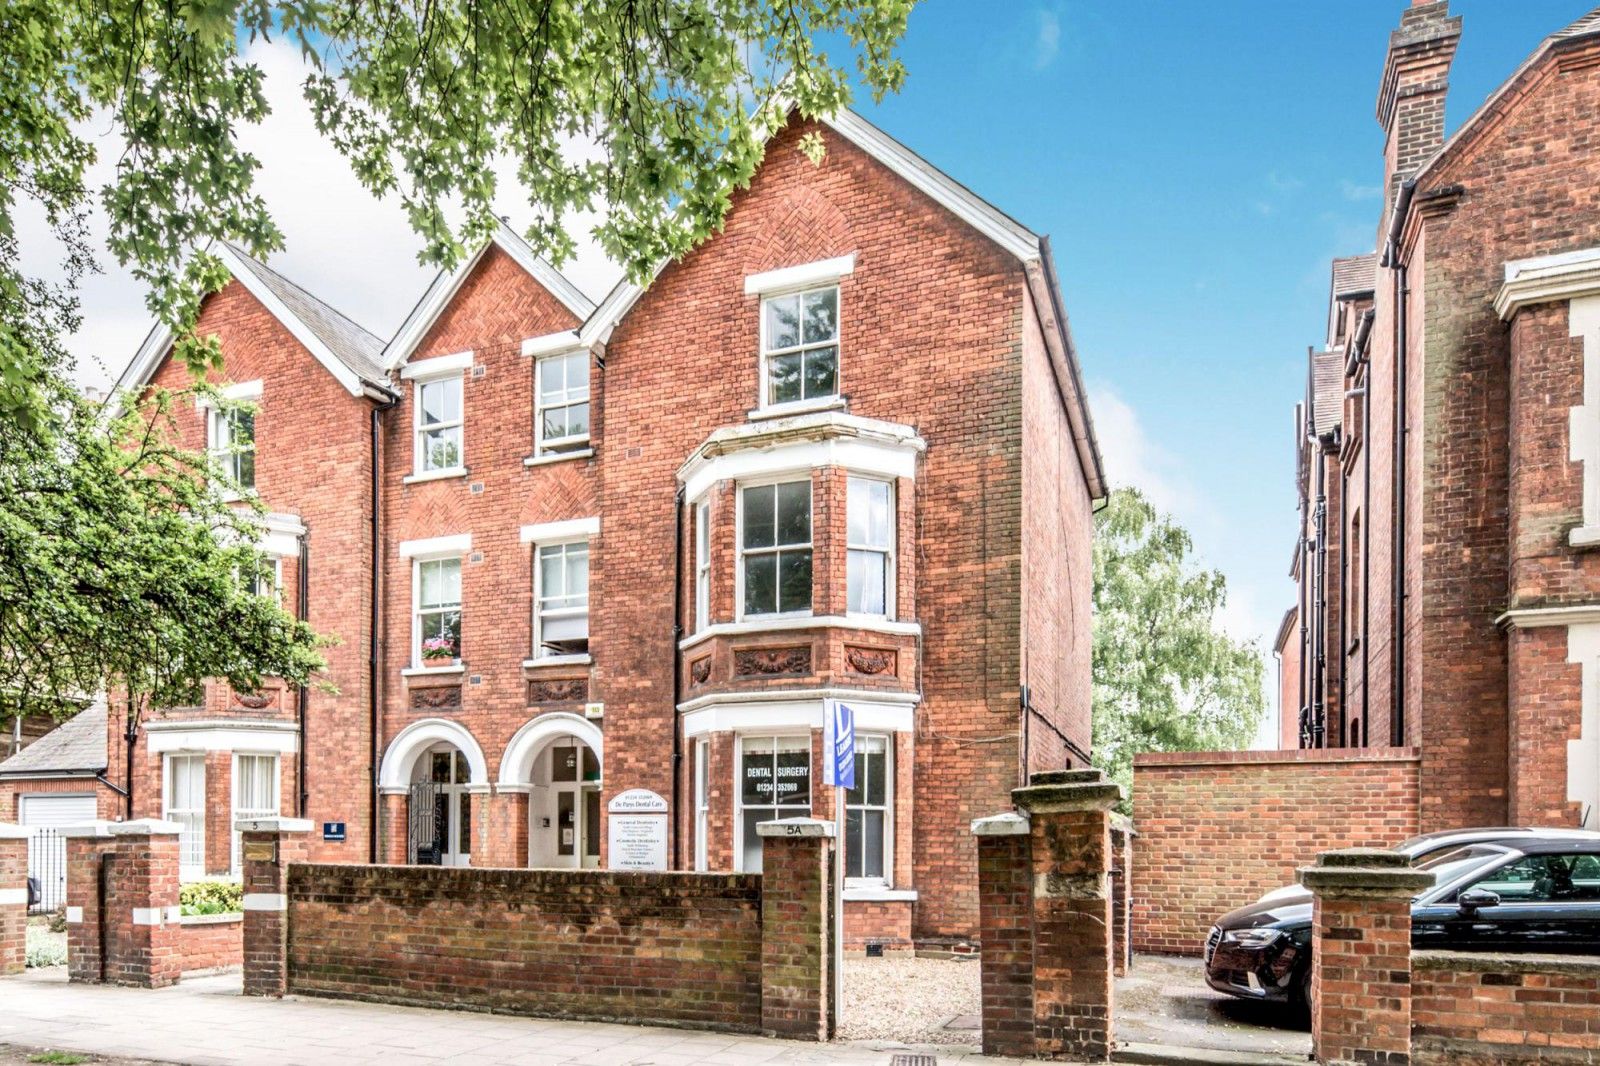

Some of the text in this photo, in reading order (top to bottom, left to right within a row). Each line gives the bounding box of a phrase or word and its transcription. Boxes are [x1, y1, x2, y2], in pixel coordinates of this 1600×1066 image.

[747, 766, 808, 777] DENTAL SURGERY
[756, 783, 773, 792] 01234
[252, 822, 258, 830] 5
[787, 825, 802, 835] 5A
